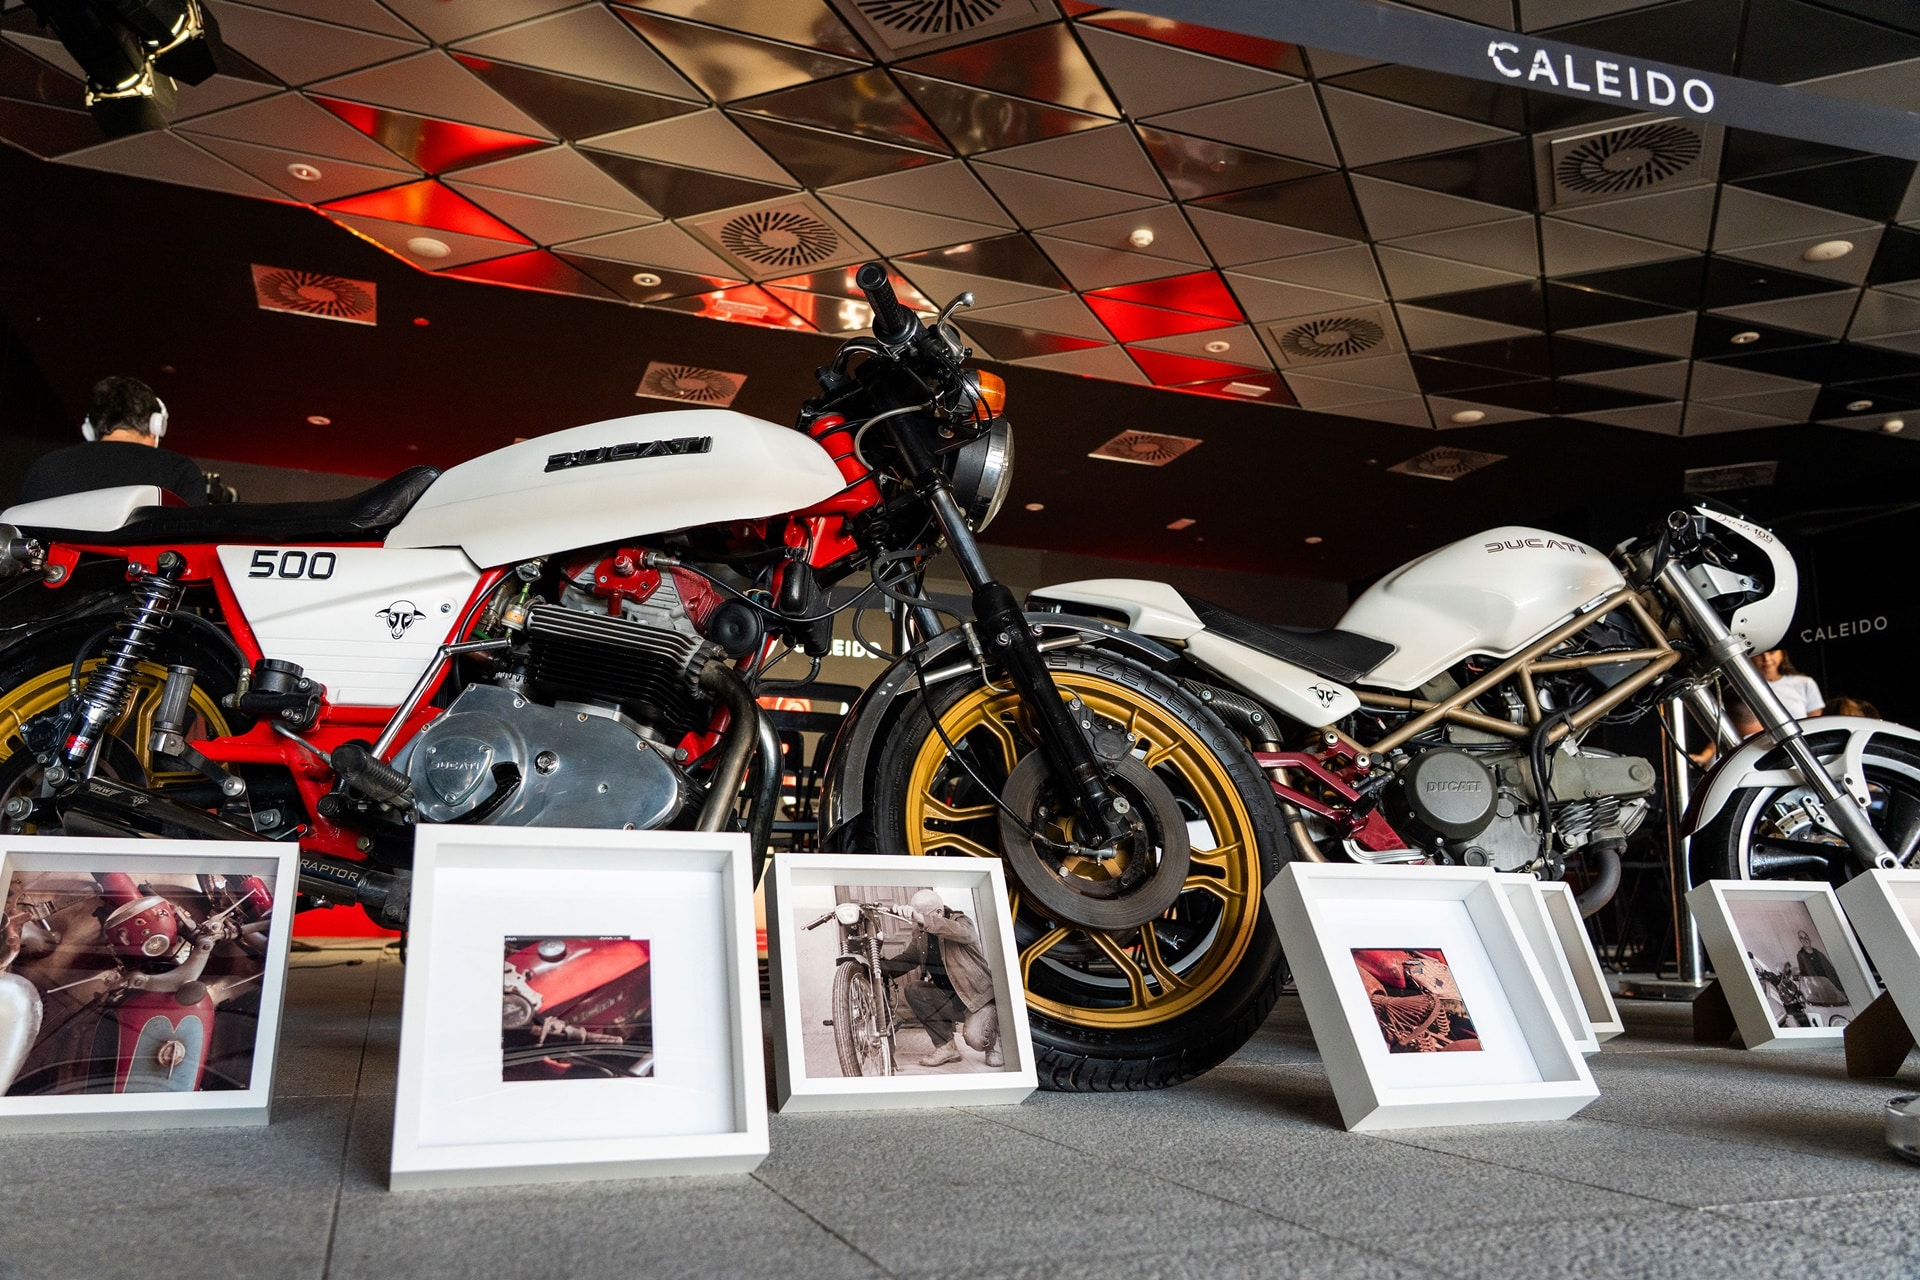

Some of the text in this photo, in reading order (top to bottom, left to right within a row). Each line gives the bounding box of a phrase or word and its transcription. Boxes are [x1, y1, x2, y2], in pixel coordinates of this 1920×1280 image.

[1487, 40, 1715, 114] CALEIDO
[544, 435, 713, 473] DUCATI
[1484, 538, 1587, 555] DUCATI
[247, 549, 337, 580] 500
[1800, 616, 1888, 643] CALEIDO
[1047, 650, 1209, 732] ETZELER
[1426, 780, 1482, 793] DUCATI
[300, 858, 359, 882] RAPTOR
